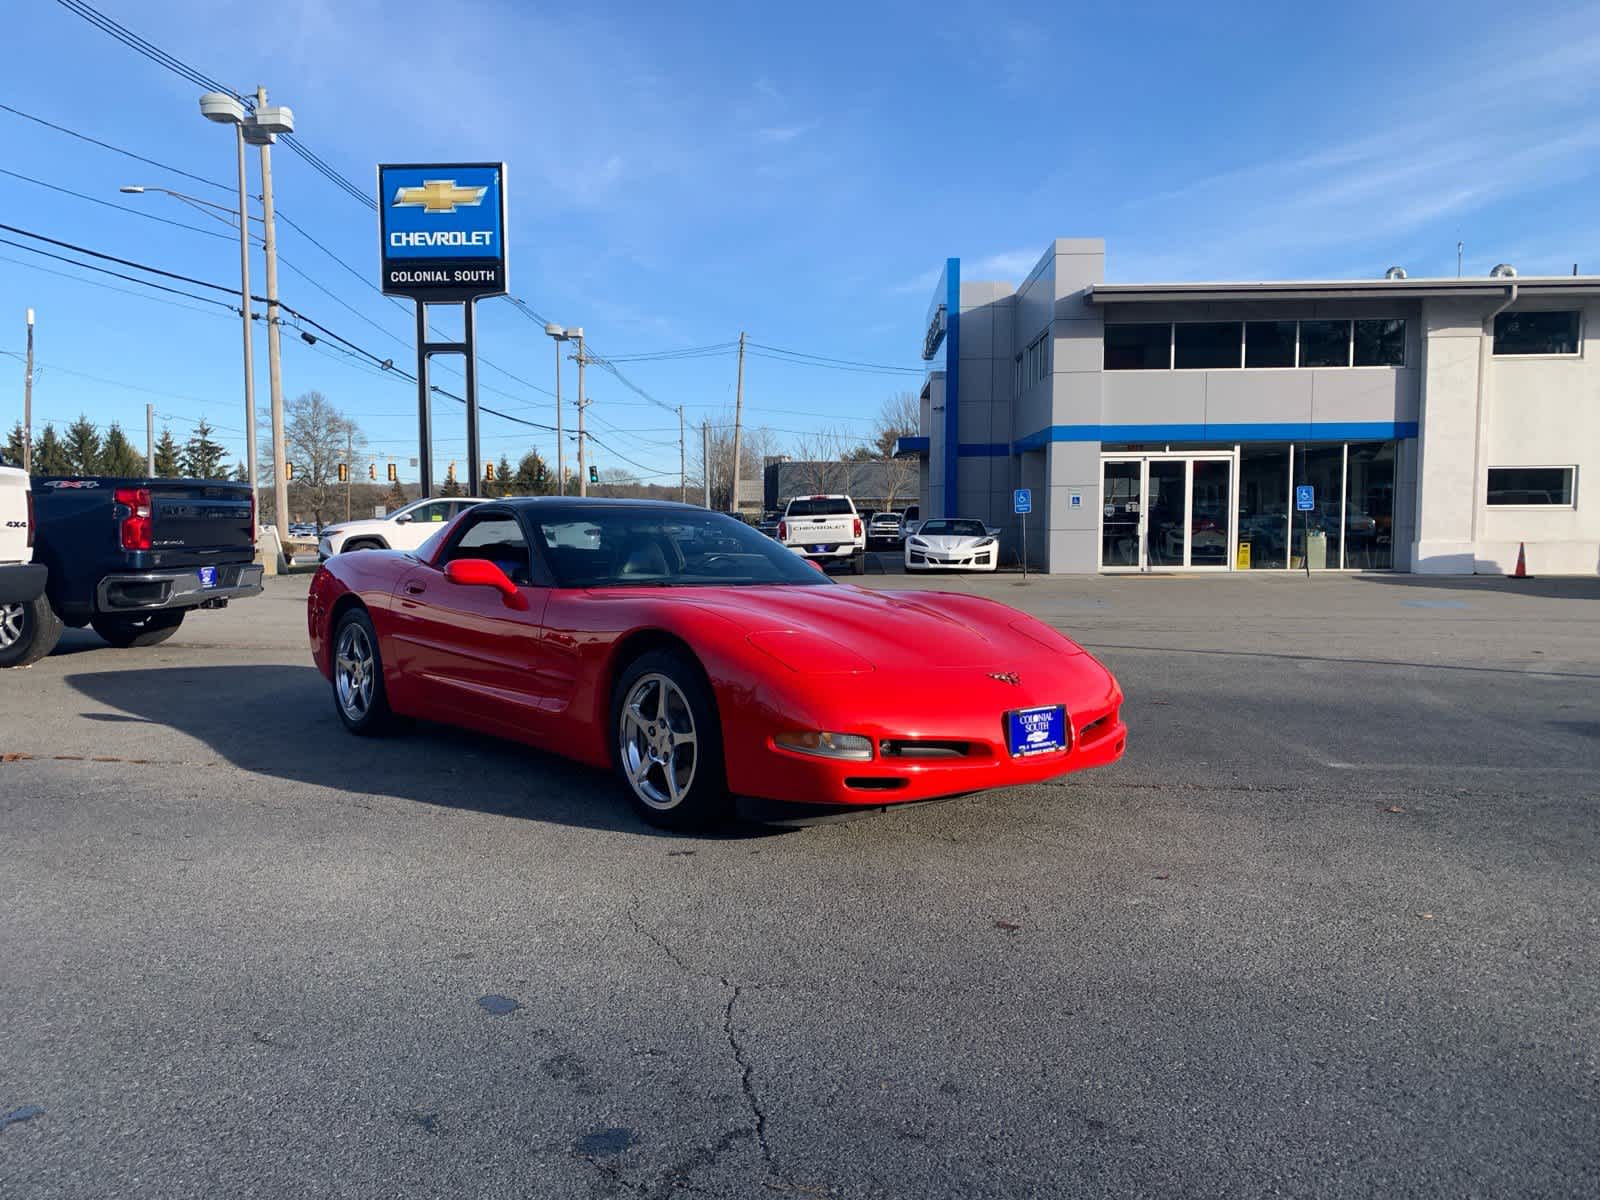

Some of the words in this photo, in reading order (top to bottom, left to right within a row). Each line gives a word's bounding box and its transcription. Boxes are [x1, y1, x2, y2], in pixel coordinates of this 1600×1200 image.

[390, 231, 493, 246] CHEVROLET
[390, 271, 450, 282] COLONIAL
[454, 270, 495, 282] SOUTH
[792, 524, 846, 532] CHEVROLET
[1019, 712, 1054, 724] COLONIAL
[1025, 721, 1049, 733] SOUTH
